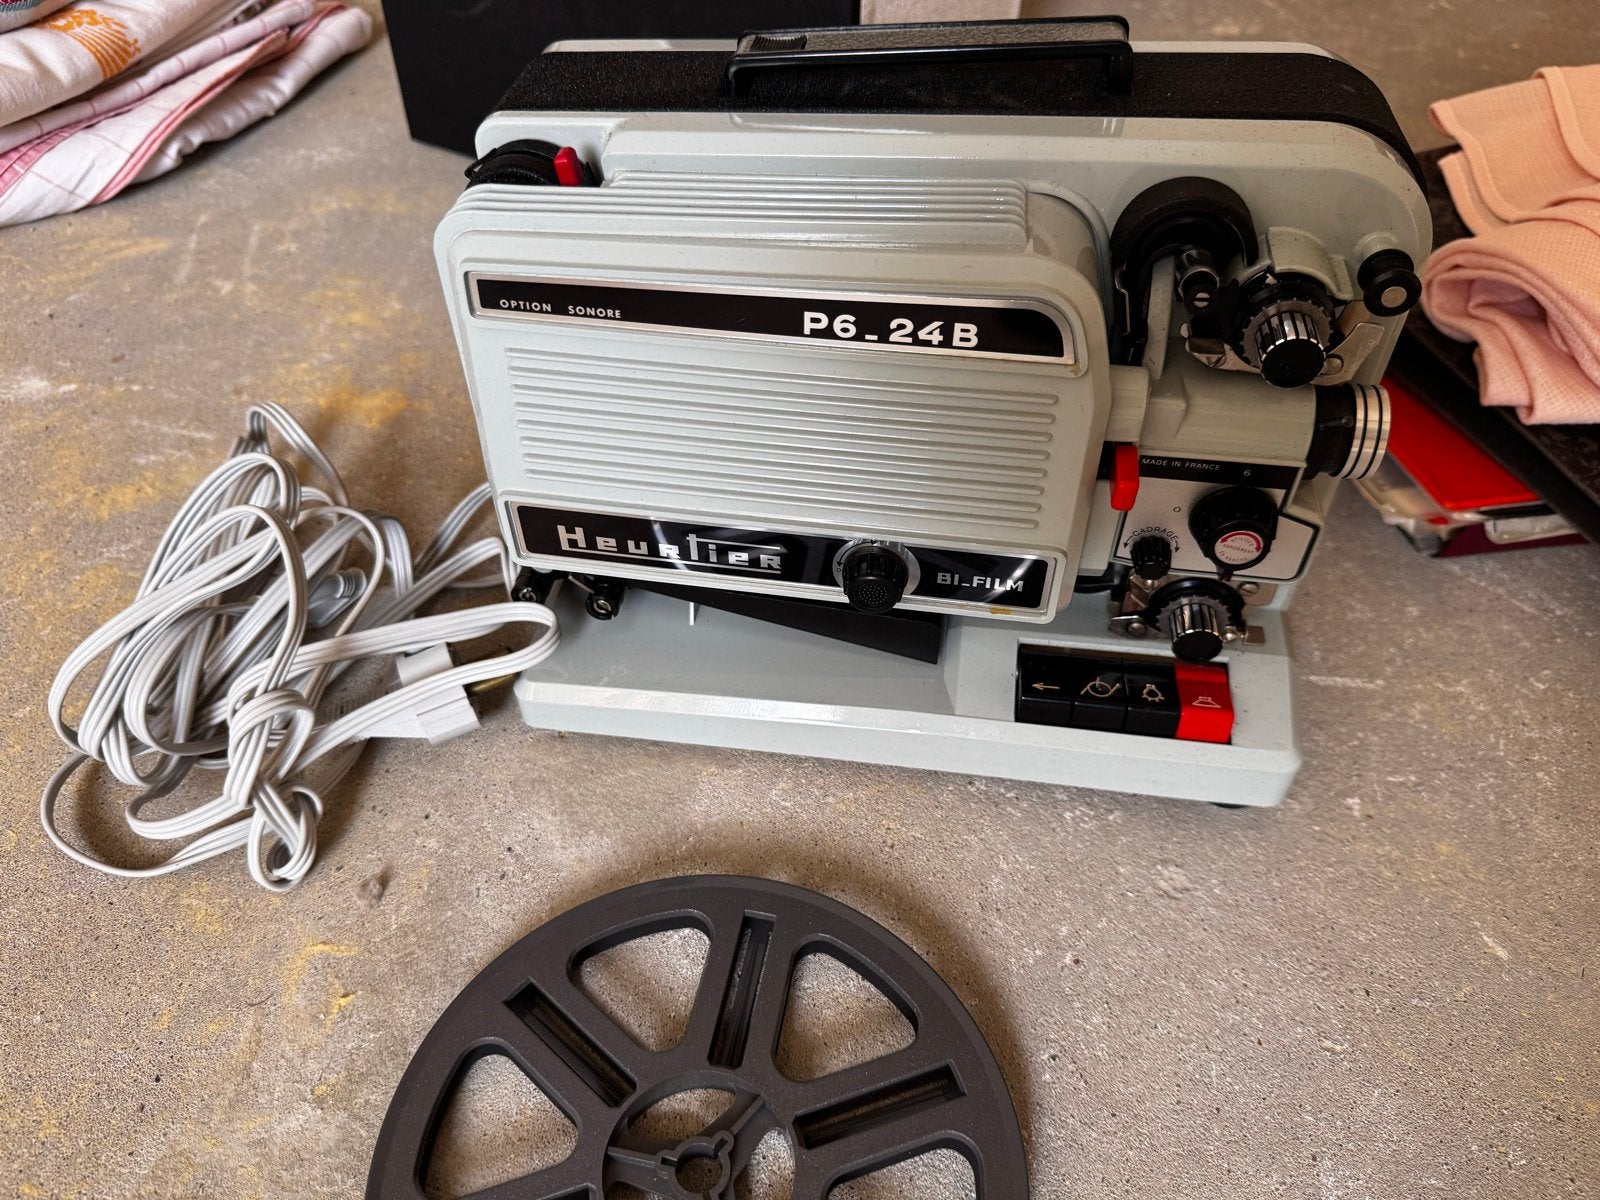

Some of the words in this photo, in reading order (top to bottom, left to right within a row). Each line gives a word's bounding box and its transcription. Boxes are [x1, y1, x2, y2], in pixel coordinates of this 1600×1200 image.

[499, 299, 551, 312] OPTION
[568, 305, 621, 318] SONORE
[1142, 458, 1168, 466] MADE
[1185, 461, 1220, 471] FRANCE
[1243, 469, 1251, 477] 6
[1132, 526, 1179, 542] CADRAGE
